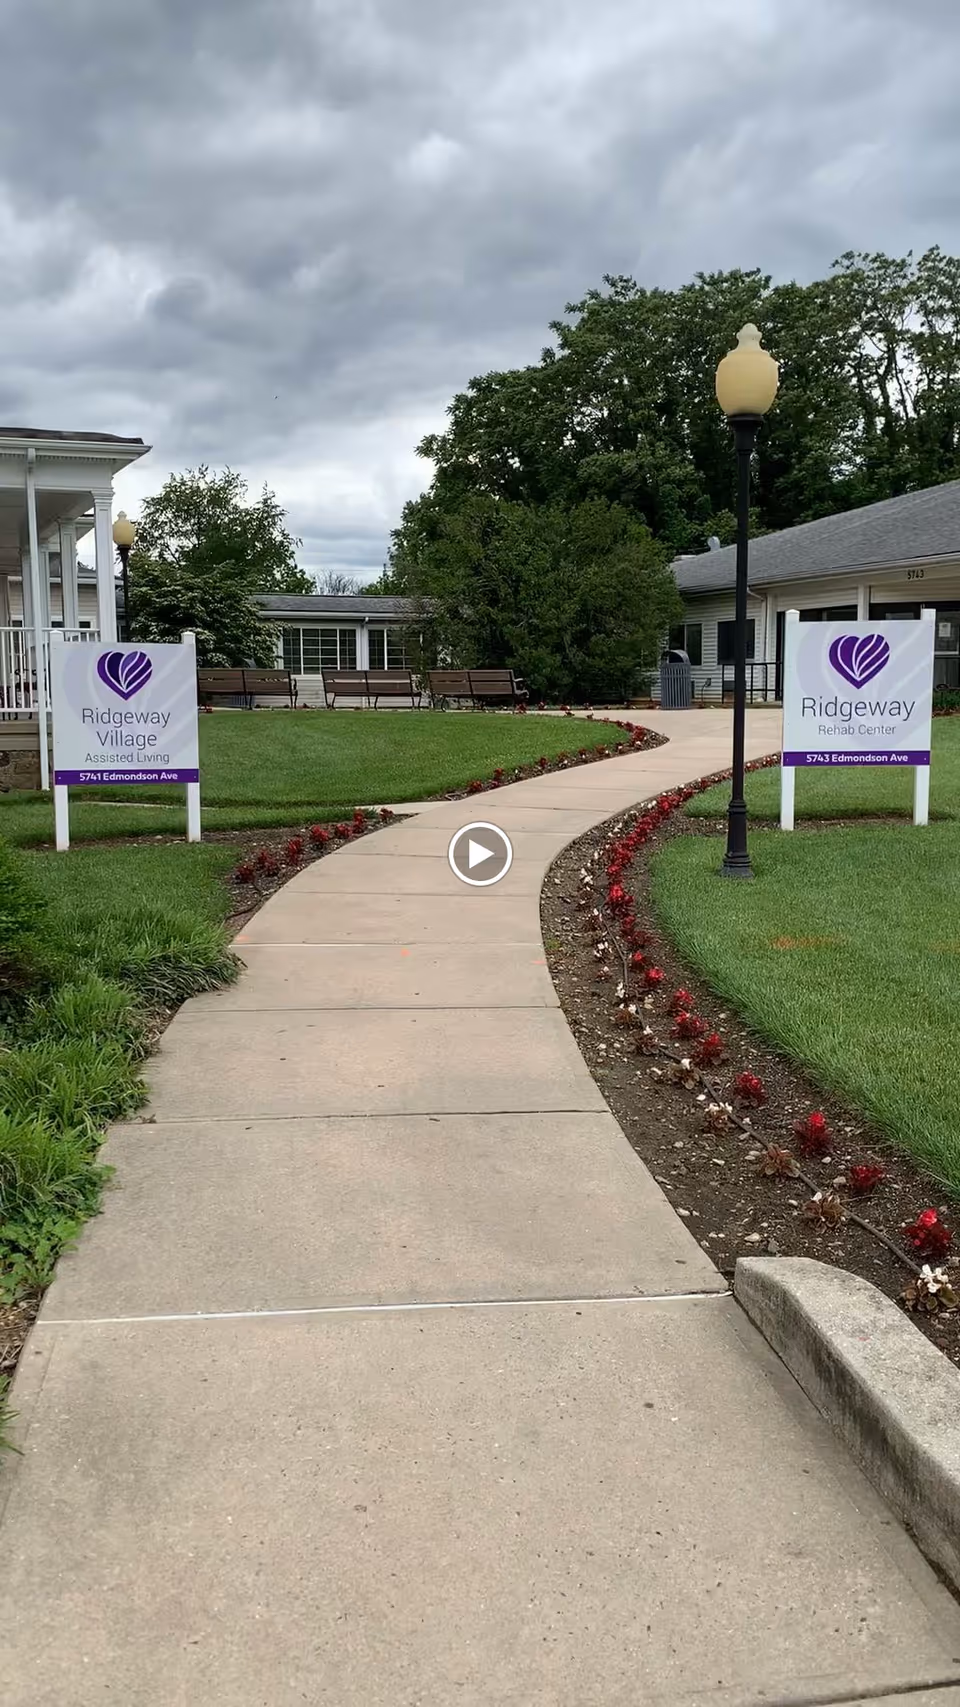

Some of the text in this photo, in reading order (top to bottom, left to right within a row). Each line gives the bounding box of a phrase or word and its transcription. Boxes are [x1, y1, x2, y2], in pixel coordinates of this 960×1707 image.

[907, 570, 924, 580] 5743
[802, 696, 916, 722] Ridgeway
[82, 708, 171, 728] Ridgeway
[818, 724, 896, 735] Rehab Center
[96, 730, 158, 750] Village
[85, 752, 170, 765] Assisted Living
[806, 753, 908, 763] 5743 Edmondson Ave
[79, 772, 178, 781] 5741 Edmondson Ave
